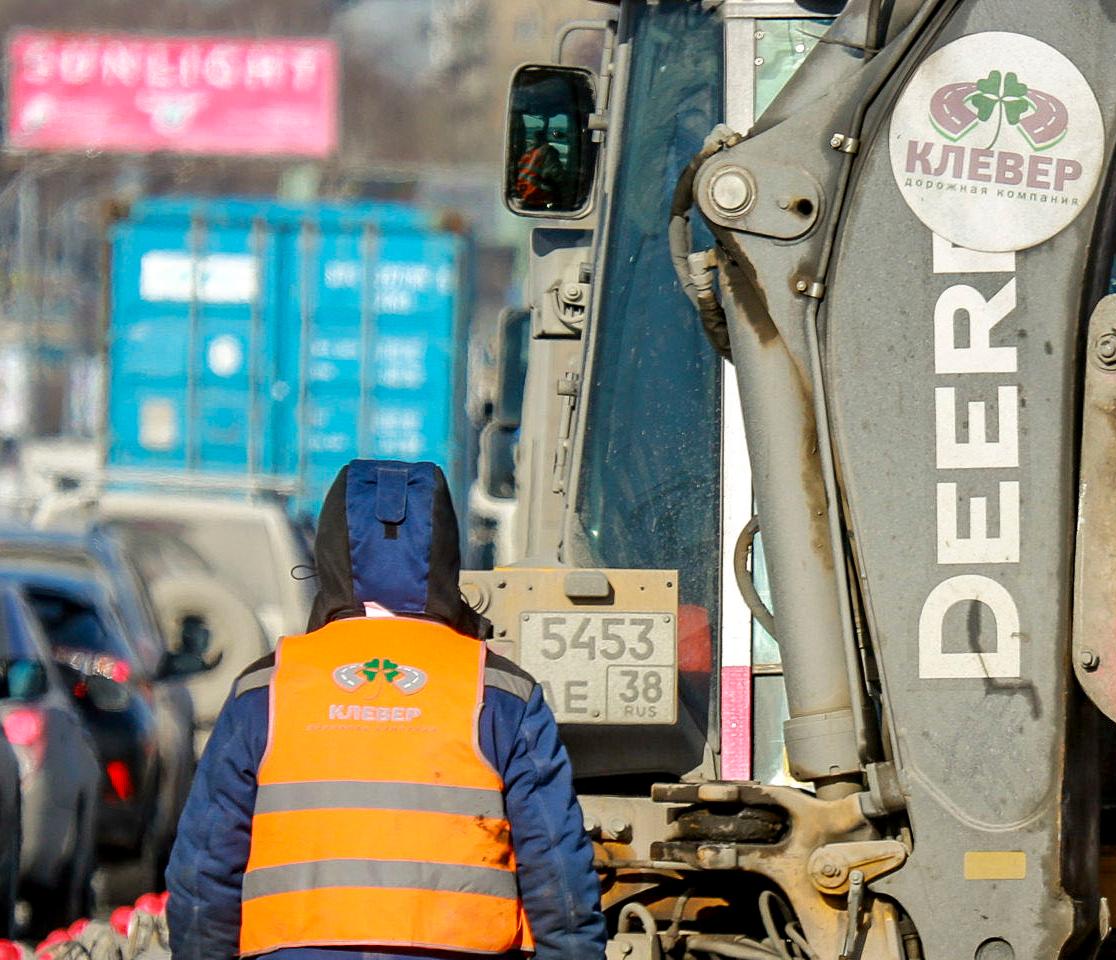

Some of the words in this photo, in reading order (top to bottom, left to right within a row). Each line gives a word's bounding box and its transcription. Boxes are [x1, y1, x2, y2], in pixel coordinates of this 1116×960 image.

[905, 139, 1083, 191] КЛЕВЕР
[904, 177, 988, 195] дорожная
[996, 189, 1080, 206] компания
[541, 617, 655, 661] 5453
[618, 670, 663, 704] 38
[328, 703, 422, 722] КЛЕВЕР
[623, 705, 657, 717] RUS
